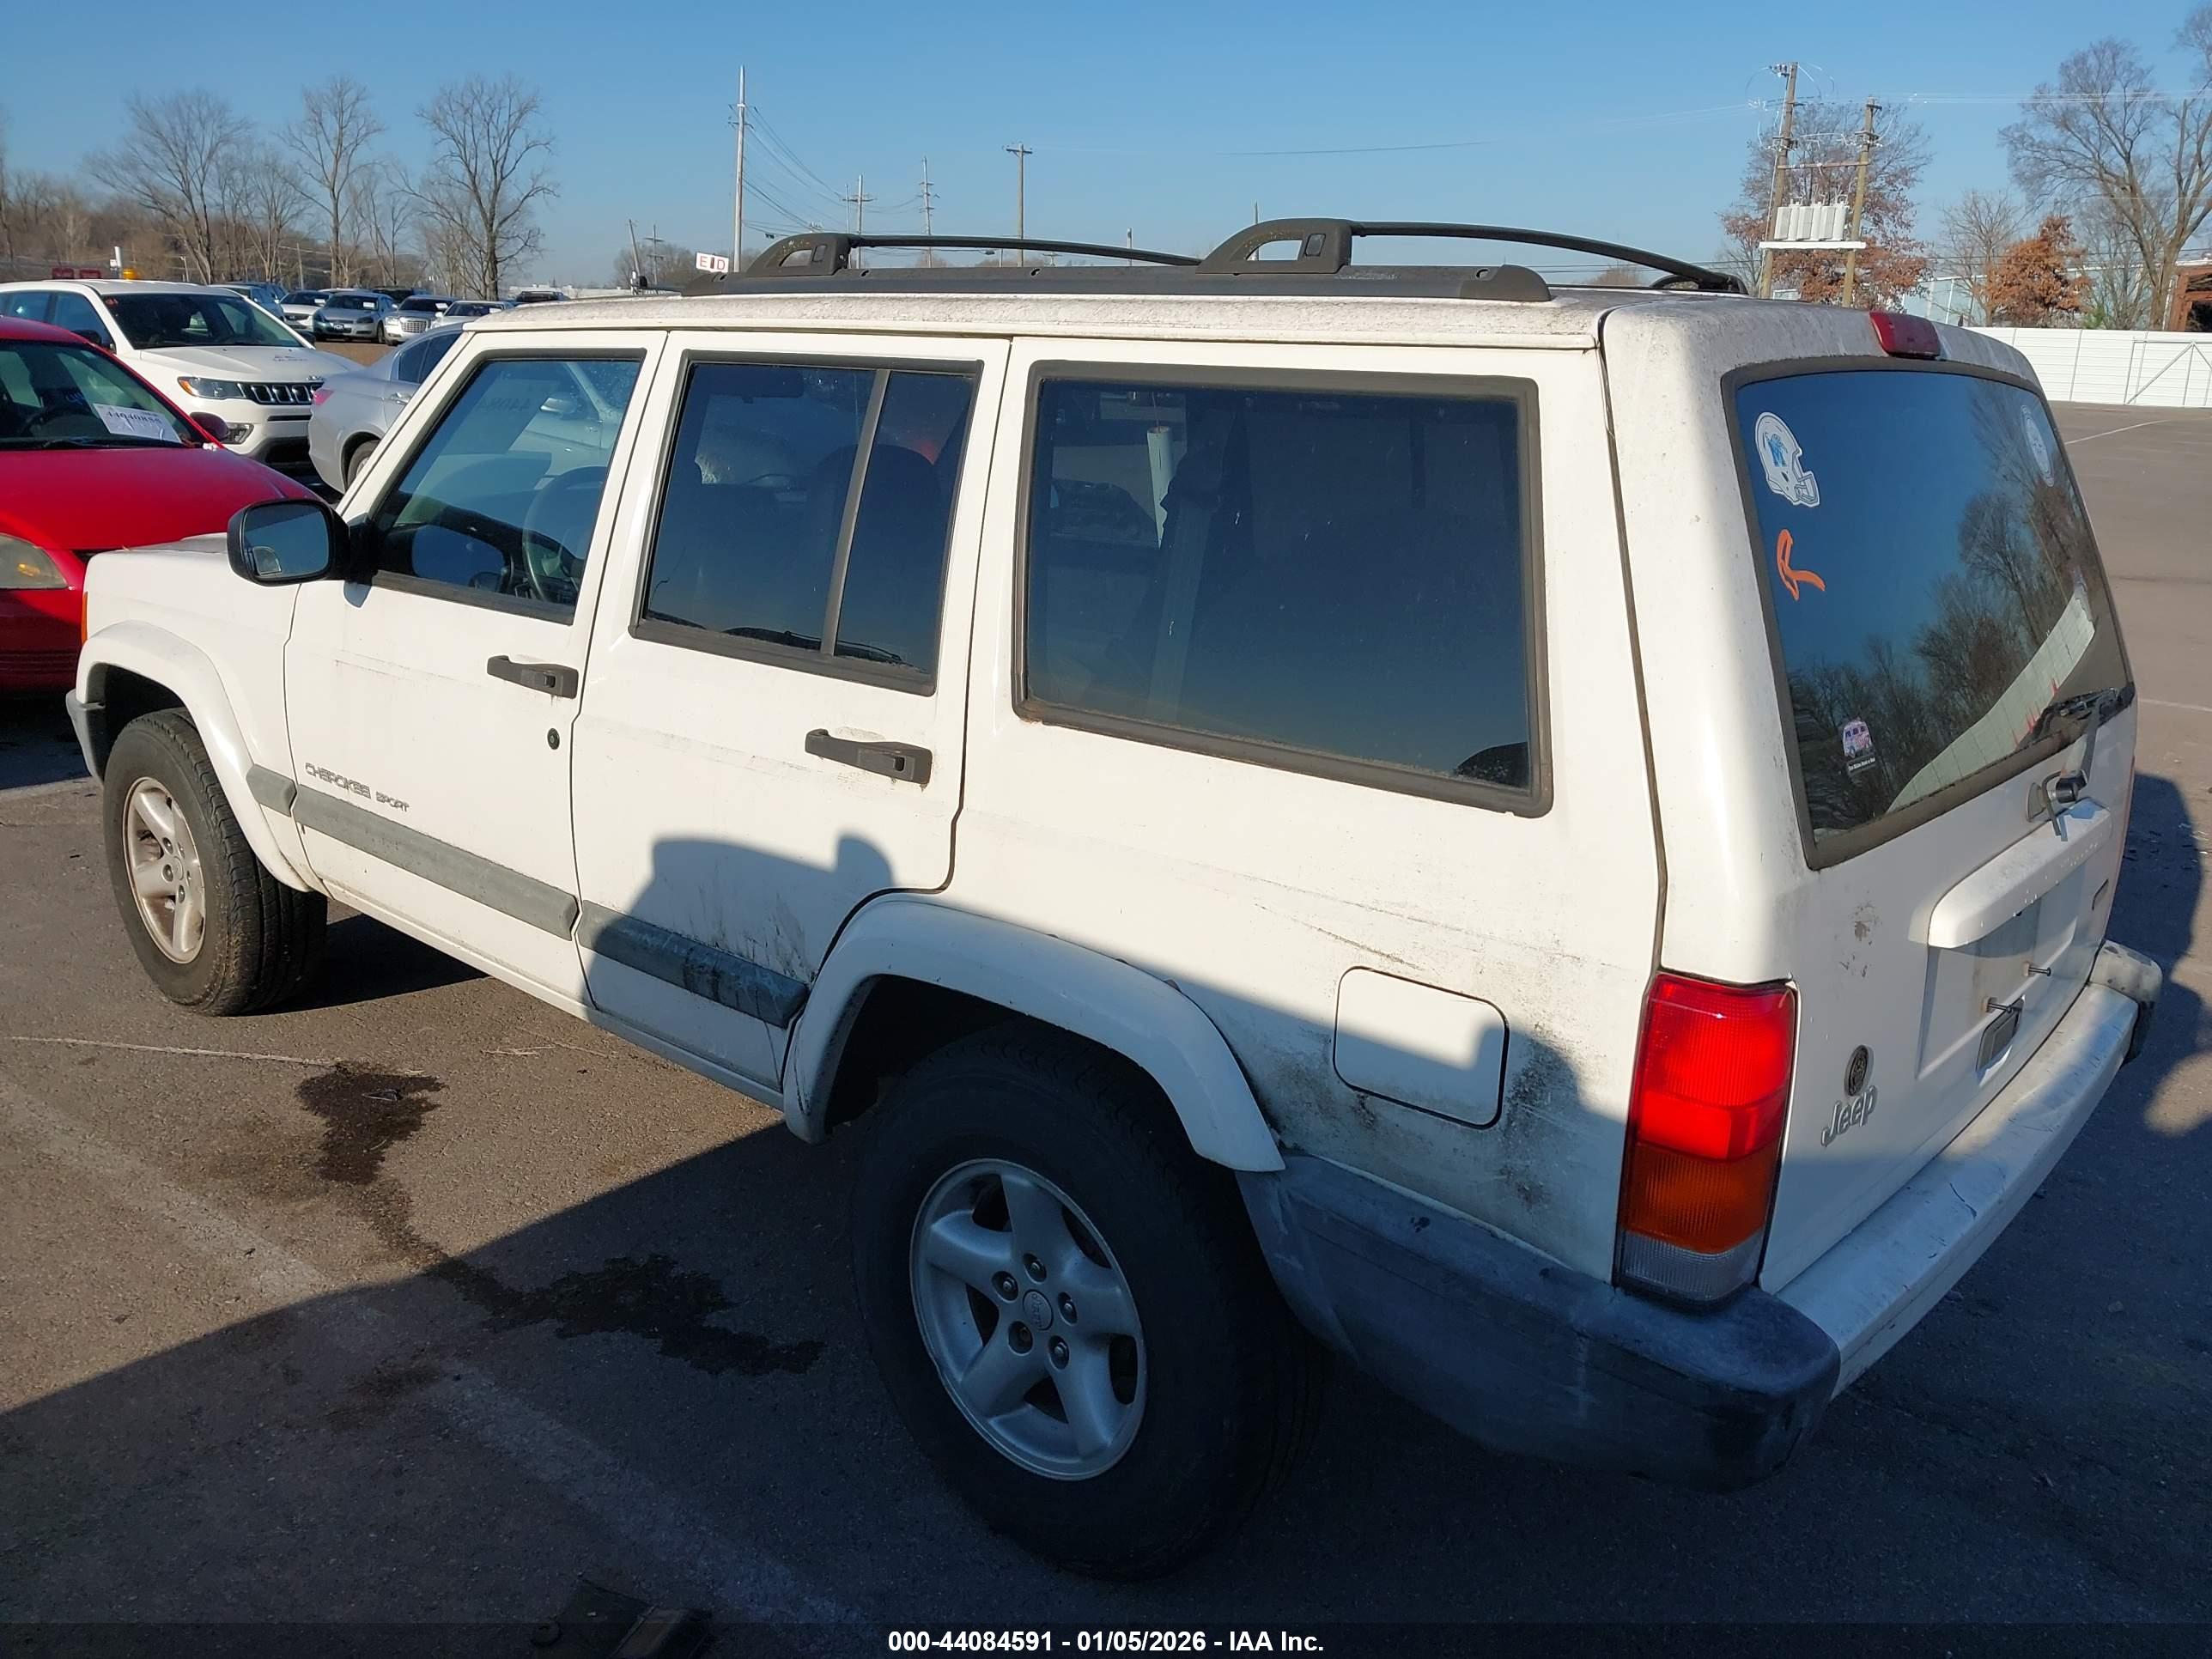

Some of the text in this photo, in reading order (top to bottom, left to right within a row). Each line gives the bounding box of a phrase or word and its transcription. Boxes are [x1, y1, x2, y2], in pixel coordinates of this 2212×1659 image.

[305, 763, 410, 812] CHEROKEE SPORT
[1821, 1085, 1878, 1147] Jeep
